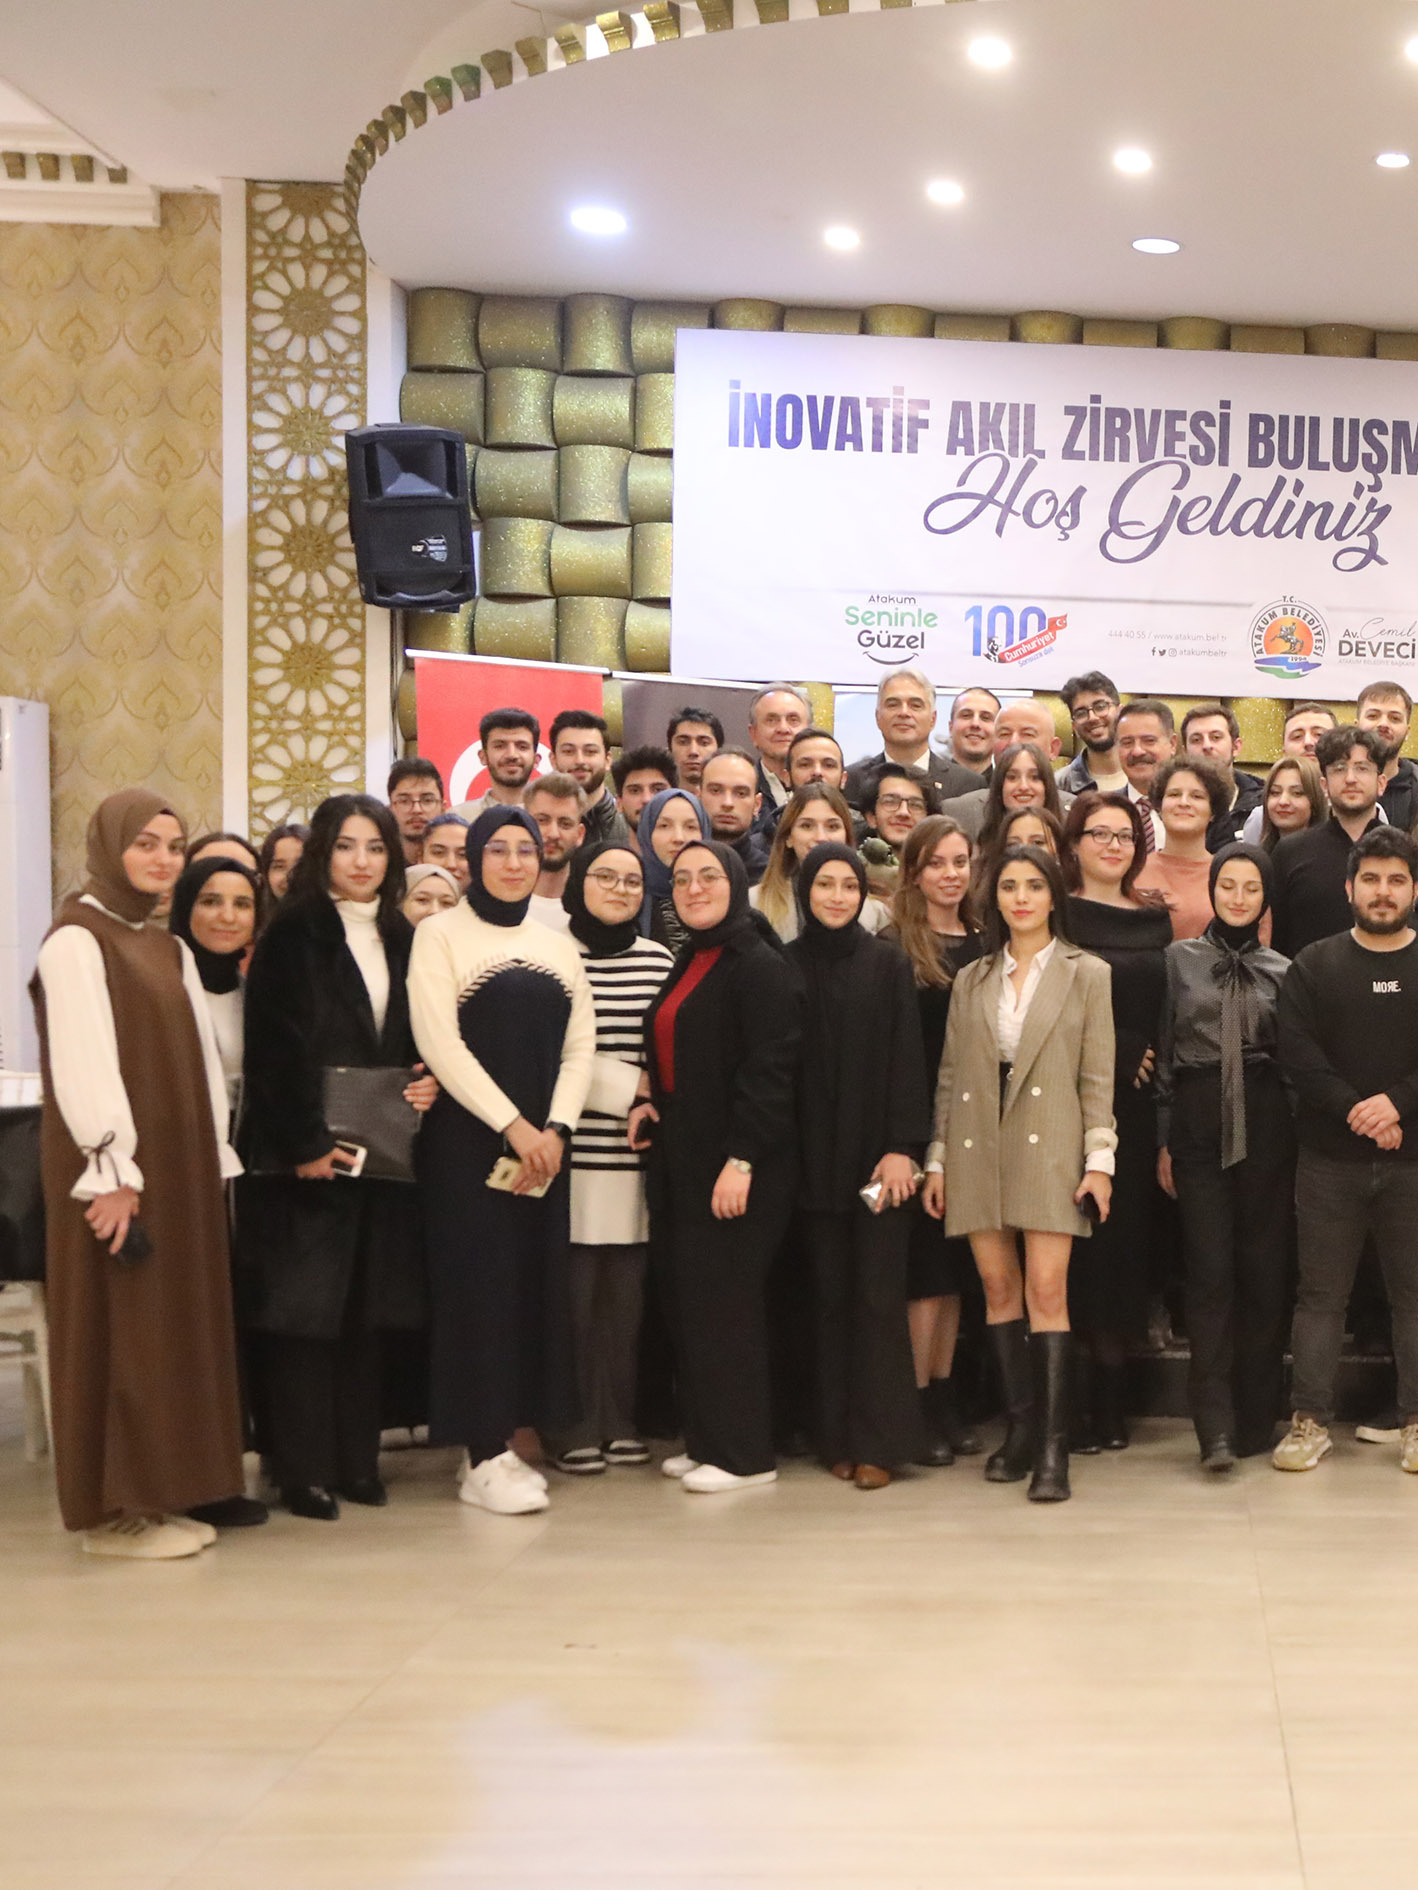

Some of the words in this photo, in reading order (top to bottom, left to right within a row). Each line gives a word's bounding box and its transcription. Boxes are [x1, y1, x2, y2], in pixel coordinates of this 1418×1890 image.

[728, 379, 931, 454] İNOVATİF
[946, 400, 1046, 460] AKIL
[1061, 394, 1231, 468] ZİRVESİ
[923, 451, 1088, 541] Hoş
[1099, 458, 1393, 573] Geldiniz
[868, 594, 917, 605] Atakum
[1282, 595, 1297, 603] T.C.
[845, 605, 938, 628] Seninle
[1342, 628, 1360, 639] Av.
[1359, 616, 1418, 640] Cemil
[857, 629, 925, 649] Güzel
[1254, 610, 1278, 656] ATAKUM
[1282, 607, 1324, 658] BELEDİYESİ
[1003, 631, 1055, 661] Cumhuriyet
[1338, 638, 1417, 659] DEVECİ
